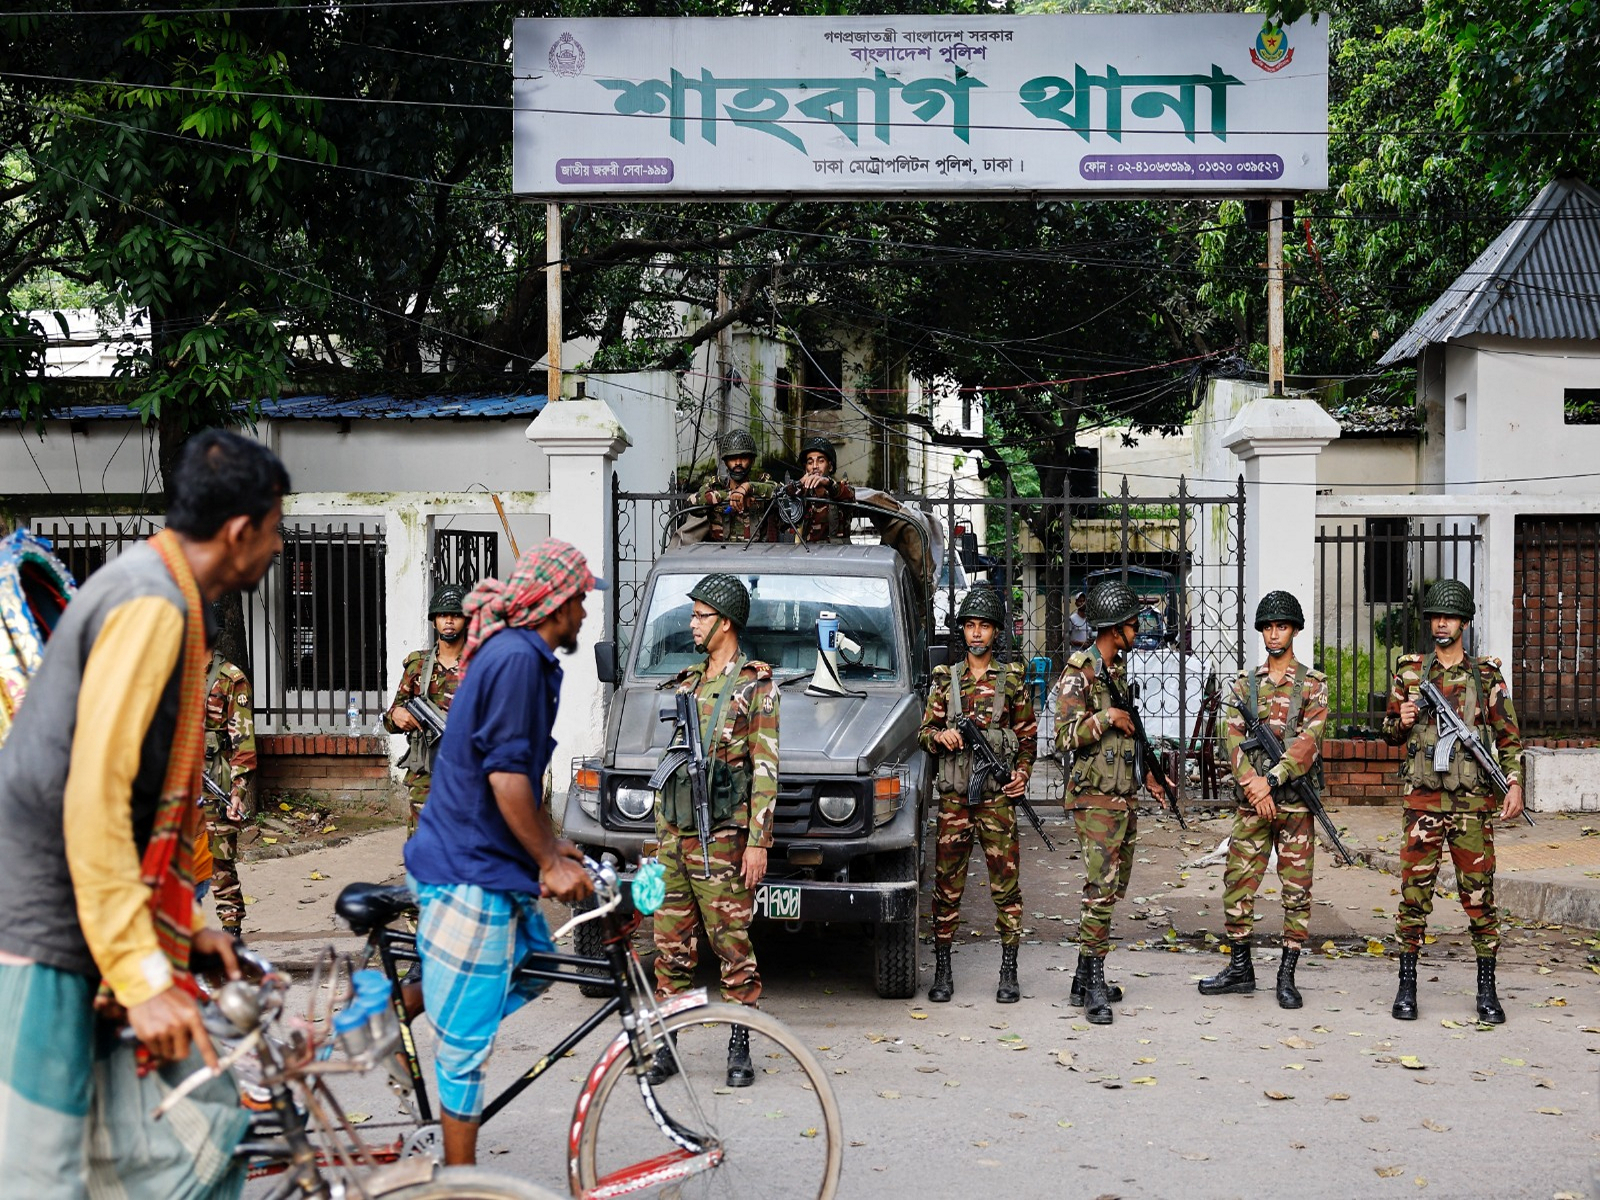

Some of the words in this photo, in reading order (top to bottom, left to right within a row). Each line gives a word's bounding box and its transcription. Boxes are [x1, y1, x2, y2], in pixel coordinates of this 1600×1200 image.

[901, 30, 964, 44] বাংলাদেশ
[967, 29, 1014, 42] সরকার
[849, 46, 931, 63] বাংলাদেশ
[938, 42, 988, 64] পুলিশ
[594, 65, 988, 156] শাহবাগ
[1018, 63, 1246, 143] থানা
[560, 161, 590, 177] জাতীয়
[592, 161, 620, 177] জরুরী
[622, 164, 668, 177] সেবা-৯৯৯
[813, 159, 844, 174] ঢাকা
[849, 155, 930, 175] মেট্রোপলিটন
[934, 154, 978, 176] পুলিশ,
[981, 158, 1014, 173] ঢাকা
[1083, 161, 1107, 173] ফোন
[1198, 161, 1233, 174] ০১৩২০
[1236, 161, 1280, 174] ০৩৯৫২৭
